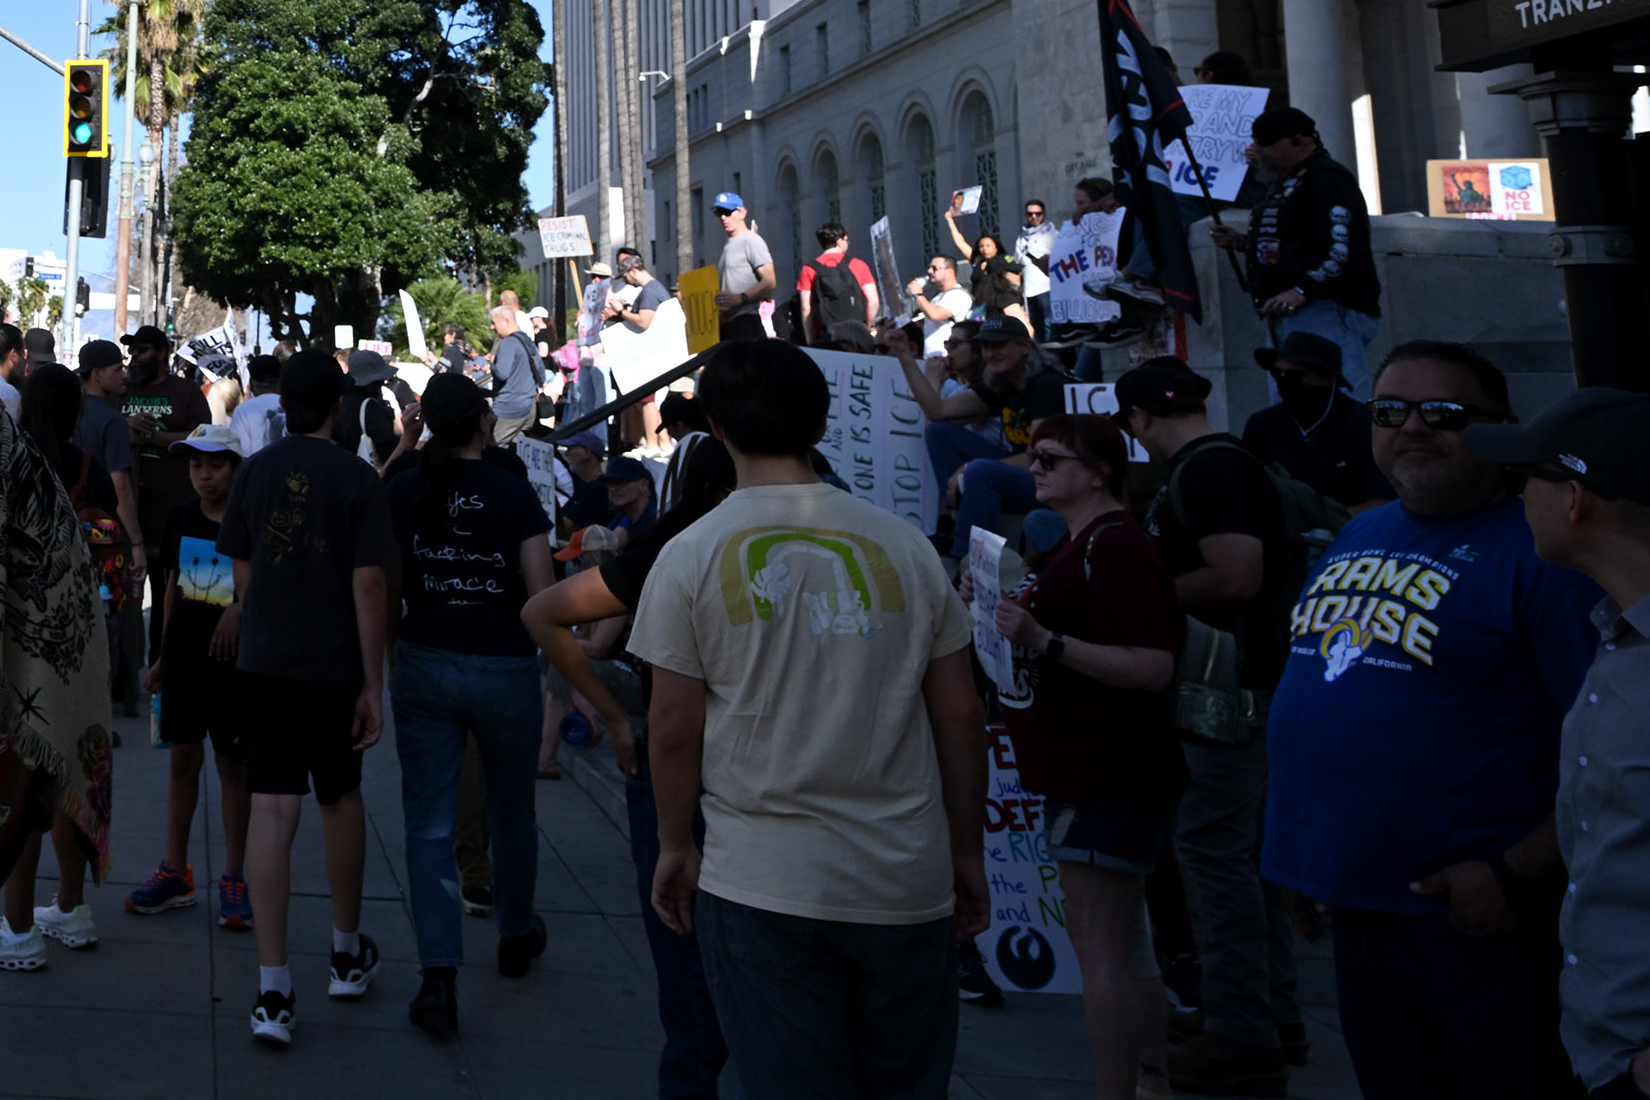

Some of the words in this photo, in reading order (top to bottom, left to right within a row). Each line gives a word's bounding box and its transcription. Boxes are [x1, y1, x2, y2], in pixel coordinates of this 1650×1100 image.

[1174, 160, 1219, 189] ICE
[1505, 191, 1530, 200] NO
[1505, 201, 1531, 211] ICE
[543, 232, 556, 242] ICE
[545, 242, 575, 253] THUGS
[1049, 249, 1090, 284] THE
[187, 335, 223, 351] FULL
[849, 365, 873, 420] SAFE
[120, 405, 173, 416] LANTERNS
[850, 427, 872, 444] IS
[853, 453, 875, 490] ONE
[1327, 551, 1360, 564] SUPER
[1360, 549, 1386, 557] BOWL
[1405, 552, 1461, 581] CHAMPIONS
[1306, 556, 1451, 611] RAMS
[1289, 595, 1441, 668] HOUSE
[1362, 656, 1413, 673] CALIFORNIA
[991, 874, 1028, 895] the
[996, 903, 1031, 923] and
